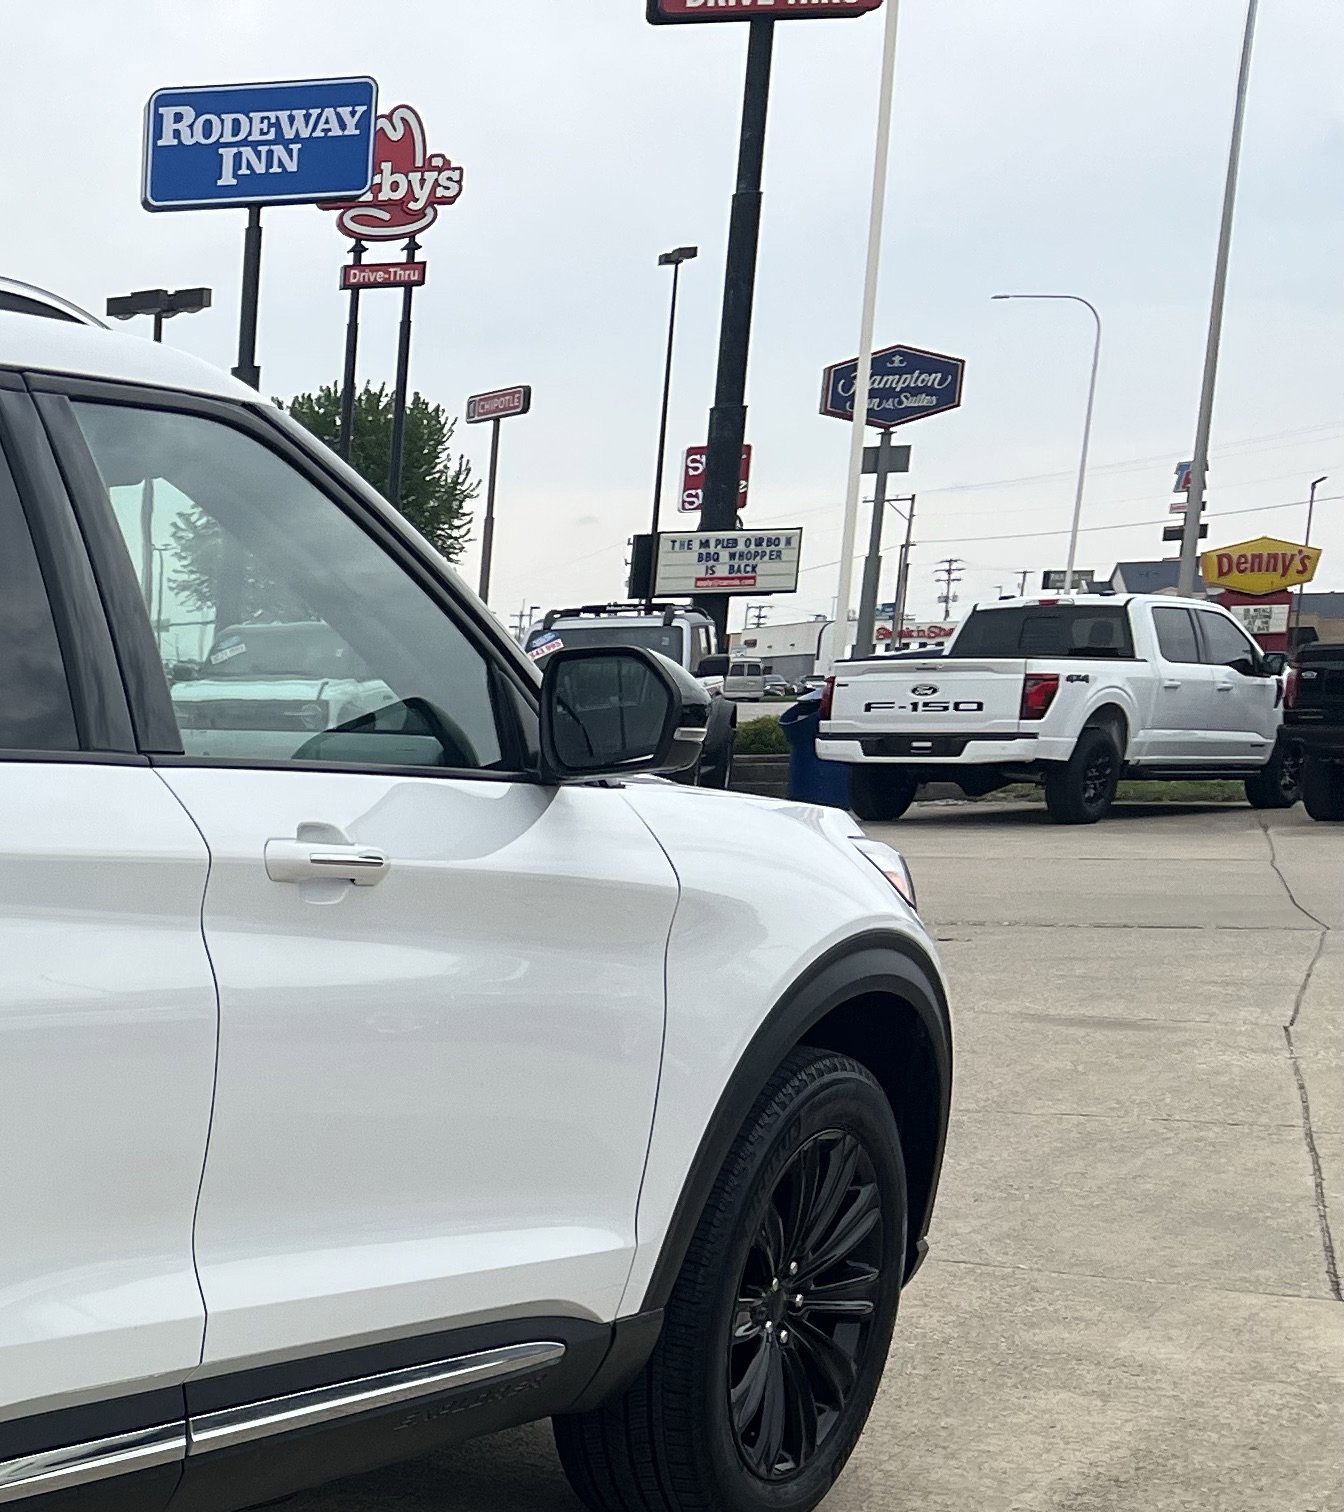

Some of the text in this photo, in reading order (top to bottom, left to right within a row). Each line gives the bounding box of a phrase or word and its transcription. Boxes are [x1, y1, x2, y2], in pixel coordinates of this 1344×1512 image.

[157, 105, 367, 146] RODEWAY
[217, 144, 301, 186] INN
[360, 157, 461, 210] rby's
[349, 267, 419, 283] Drive-Thru
[478, 393, 521, 413] CHIPOTLE
[895, 393, 937, 409] Suites
[670, 540, 694, 551] THE
[697, 549, 783, 563] BBQ WHOPPER
[1216, 548, 1312, 578] Denny's
[704, 564, 758, 577] IS BACK
[864, 701, 984, 713] F-150
